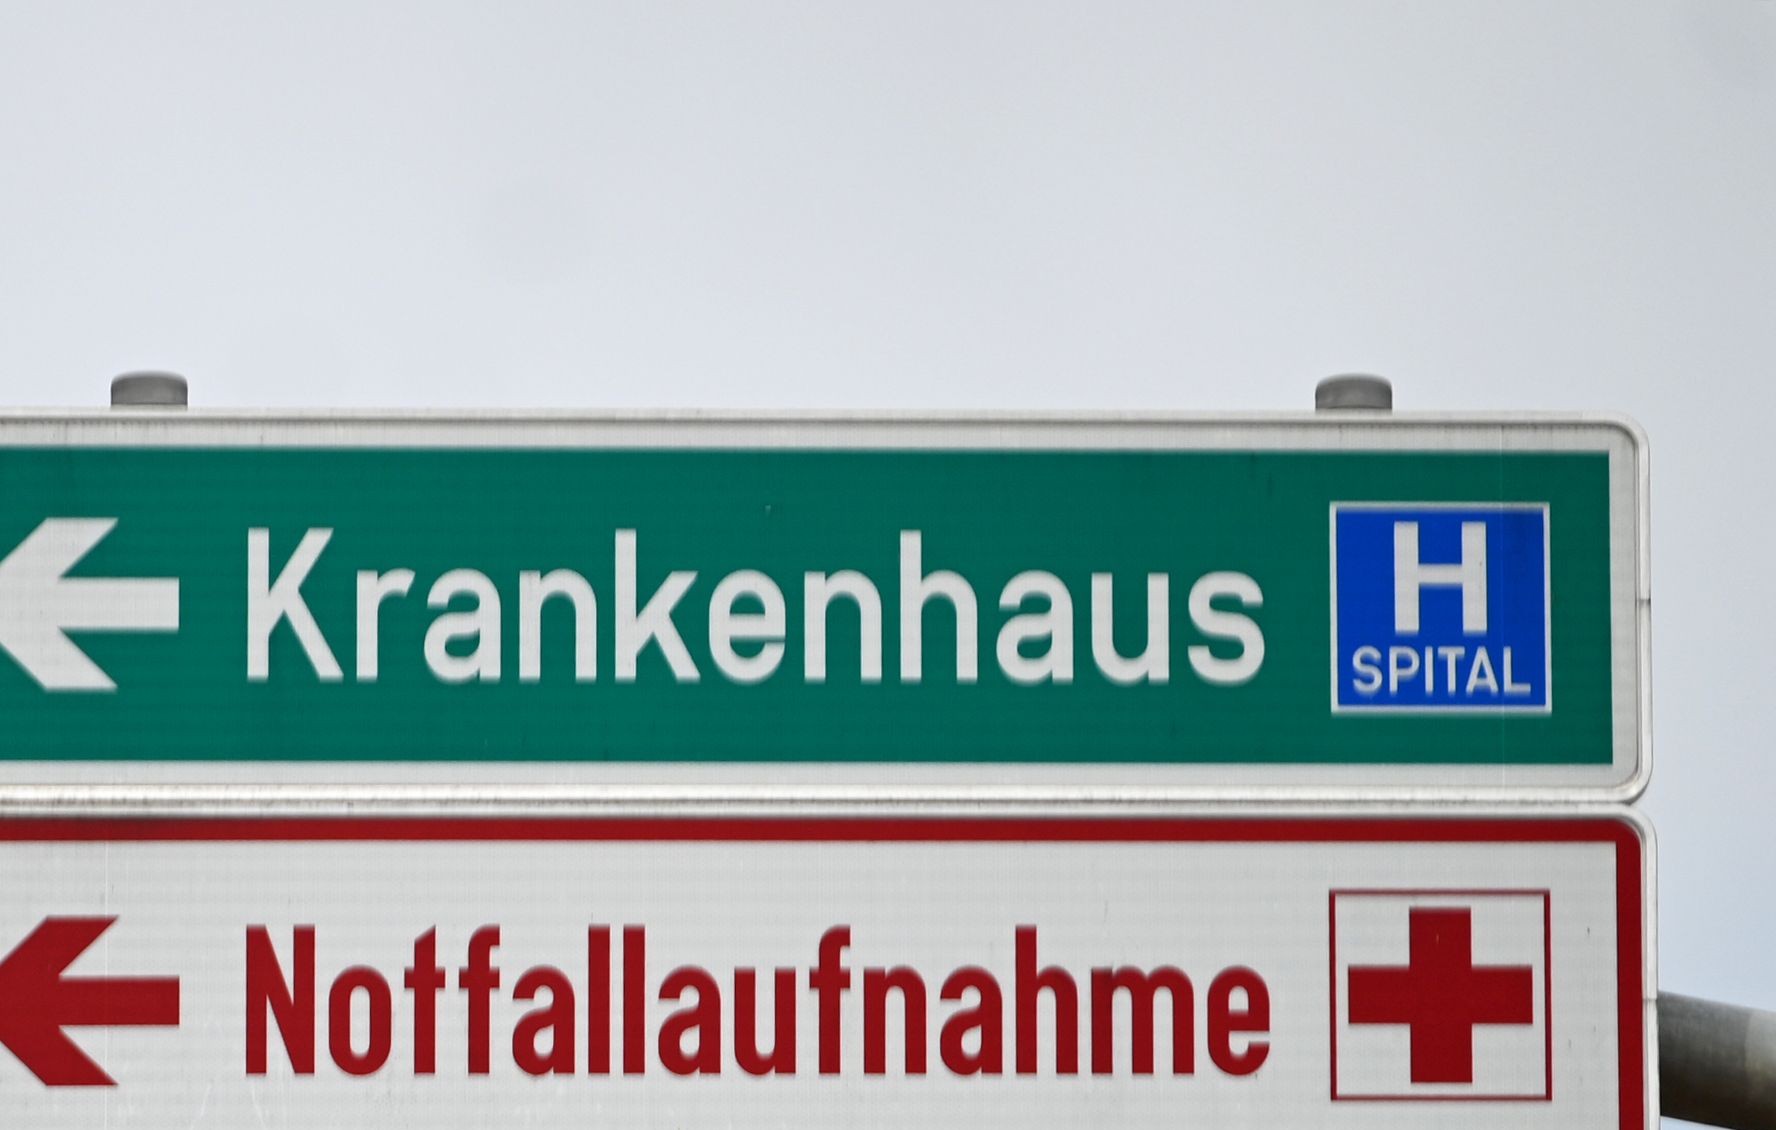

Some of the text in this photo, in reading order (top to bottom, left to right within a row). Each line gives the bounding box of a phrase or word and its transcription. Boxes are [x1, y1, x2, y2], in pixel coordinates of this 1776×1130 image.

[246, 528, 1266, 684] Krankenhaus
[1394, 521, 1487, 634] H
[1352, 646, 1531, 695] SPITAL
[246, 923, 1270, 1076] Notfallaufnahme
